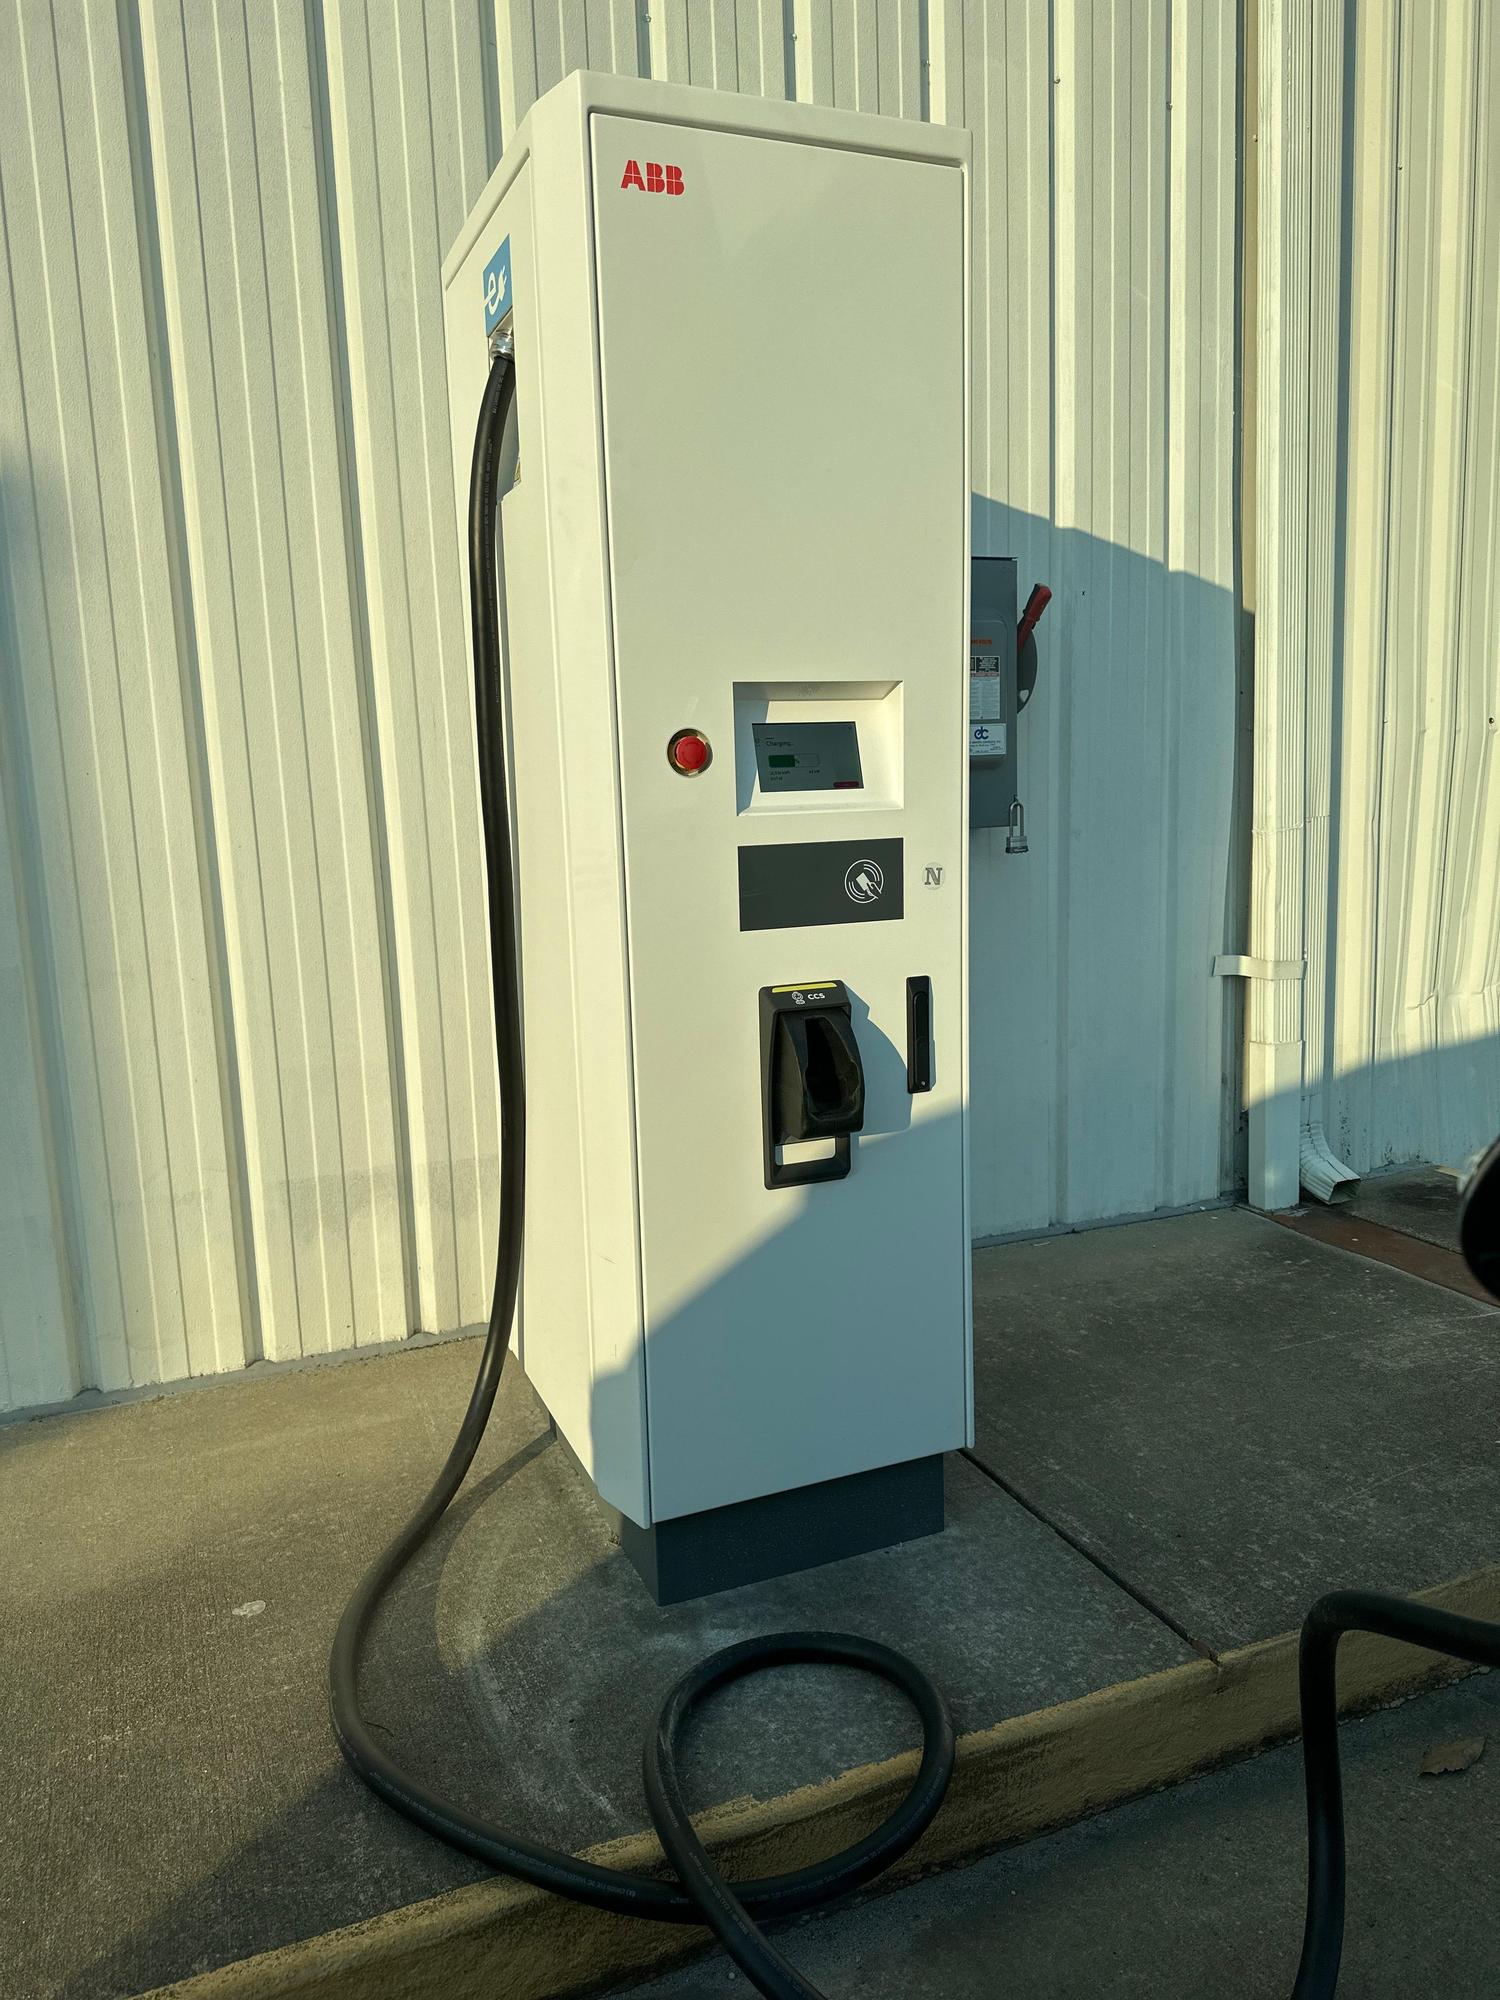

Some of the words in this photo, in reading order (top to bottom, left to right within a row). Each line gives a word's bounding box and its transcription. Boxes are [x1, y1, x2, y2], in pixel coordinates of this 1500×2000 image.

[621, 160, 684, 195] ABB
[924, 867, 942, 885] N
[807, 992, 825, 1000] CCS
